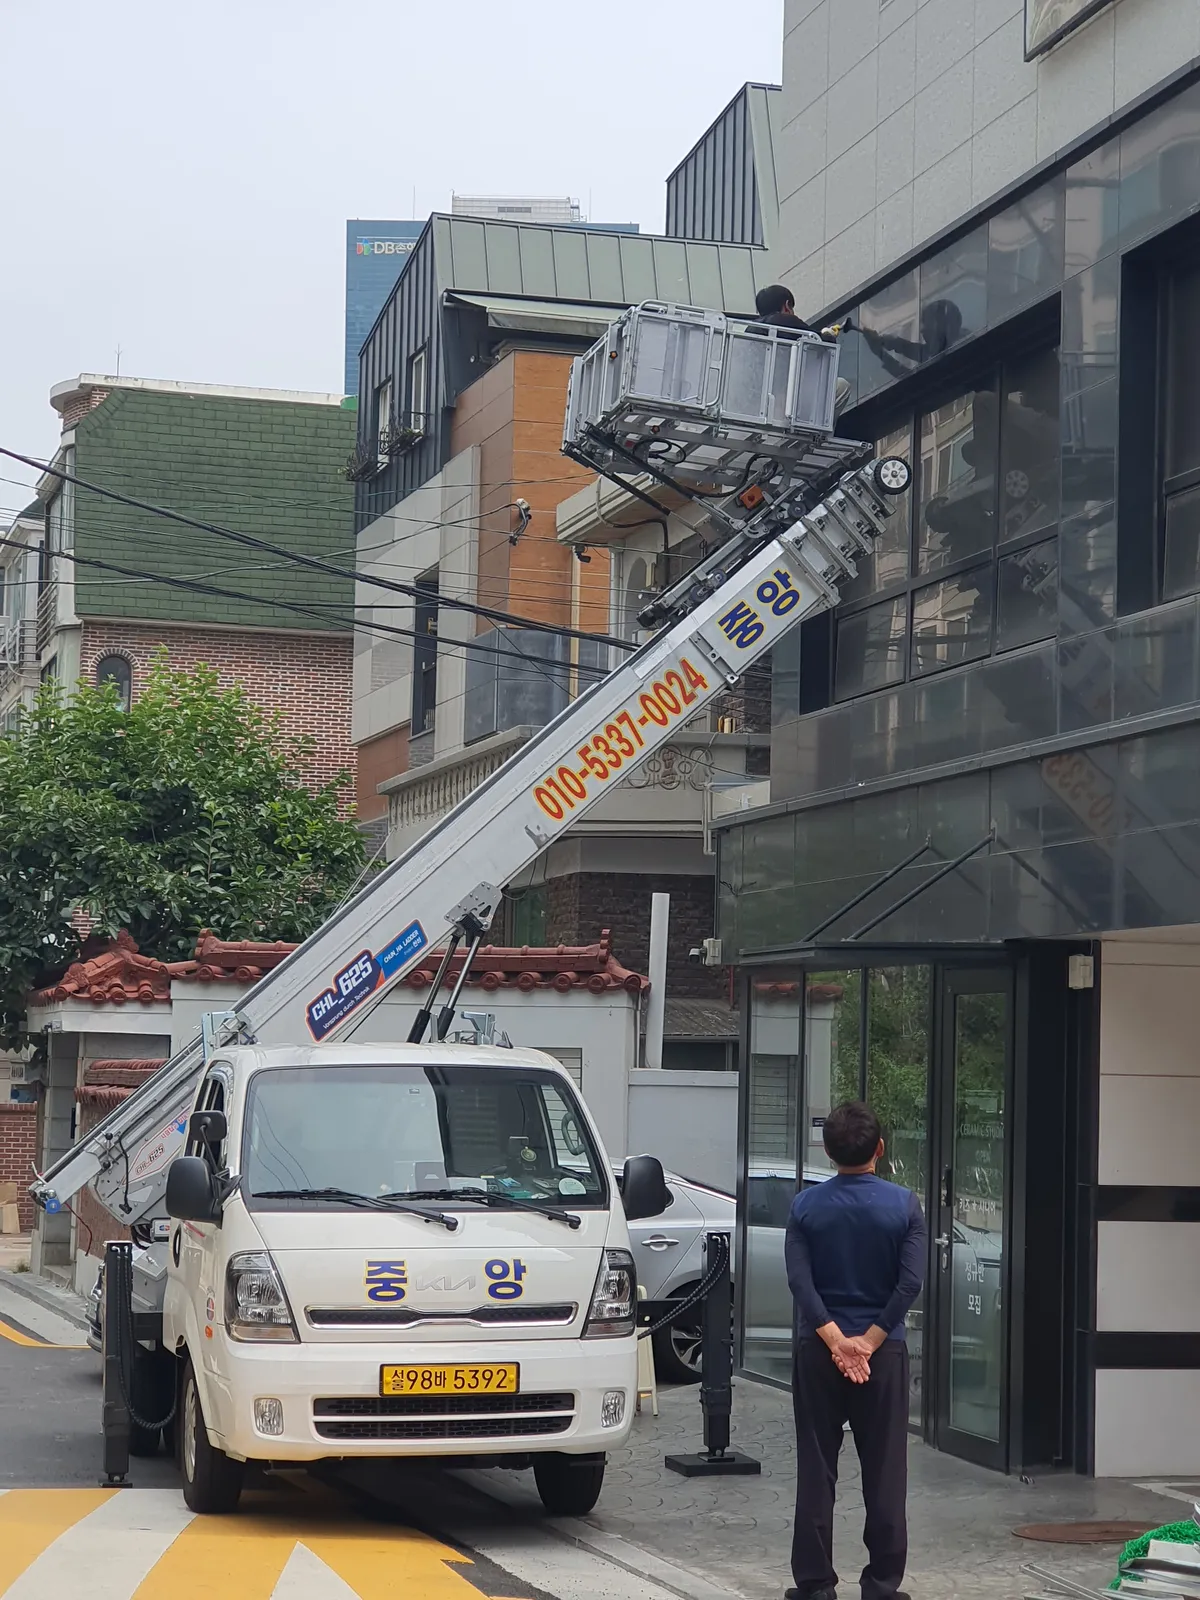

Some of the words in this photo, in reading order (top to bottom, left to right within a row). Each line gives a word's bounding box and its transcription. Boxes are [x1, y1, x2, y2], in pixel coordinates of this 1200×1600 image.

[533, 657, 708, 822] 010-5337-0024
[311, 955, 373, 1021] CHL_625
[968, 1294, 981, 1315] 모집
[453, 1368, 508, 1390] 5392
